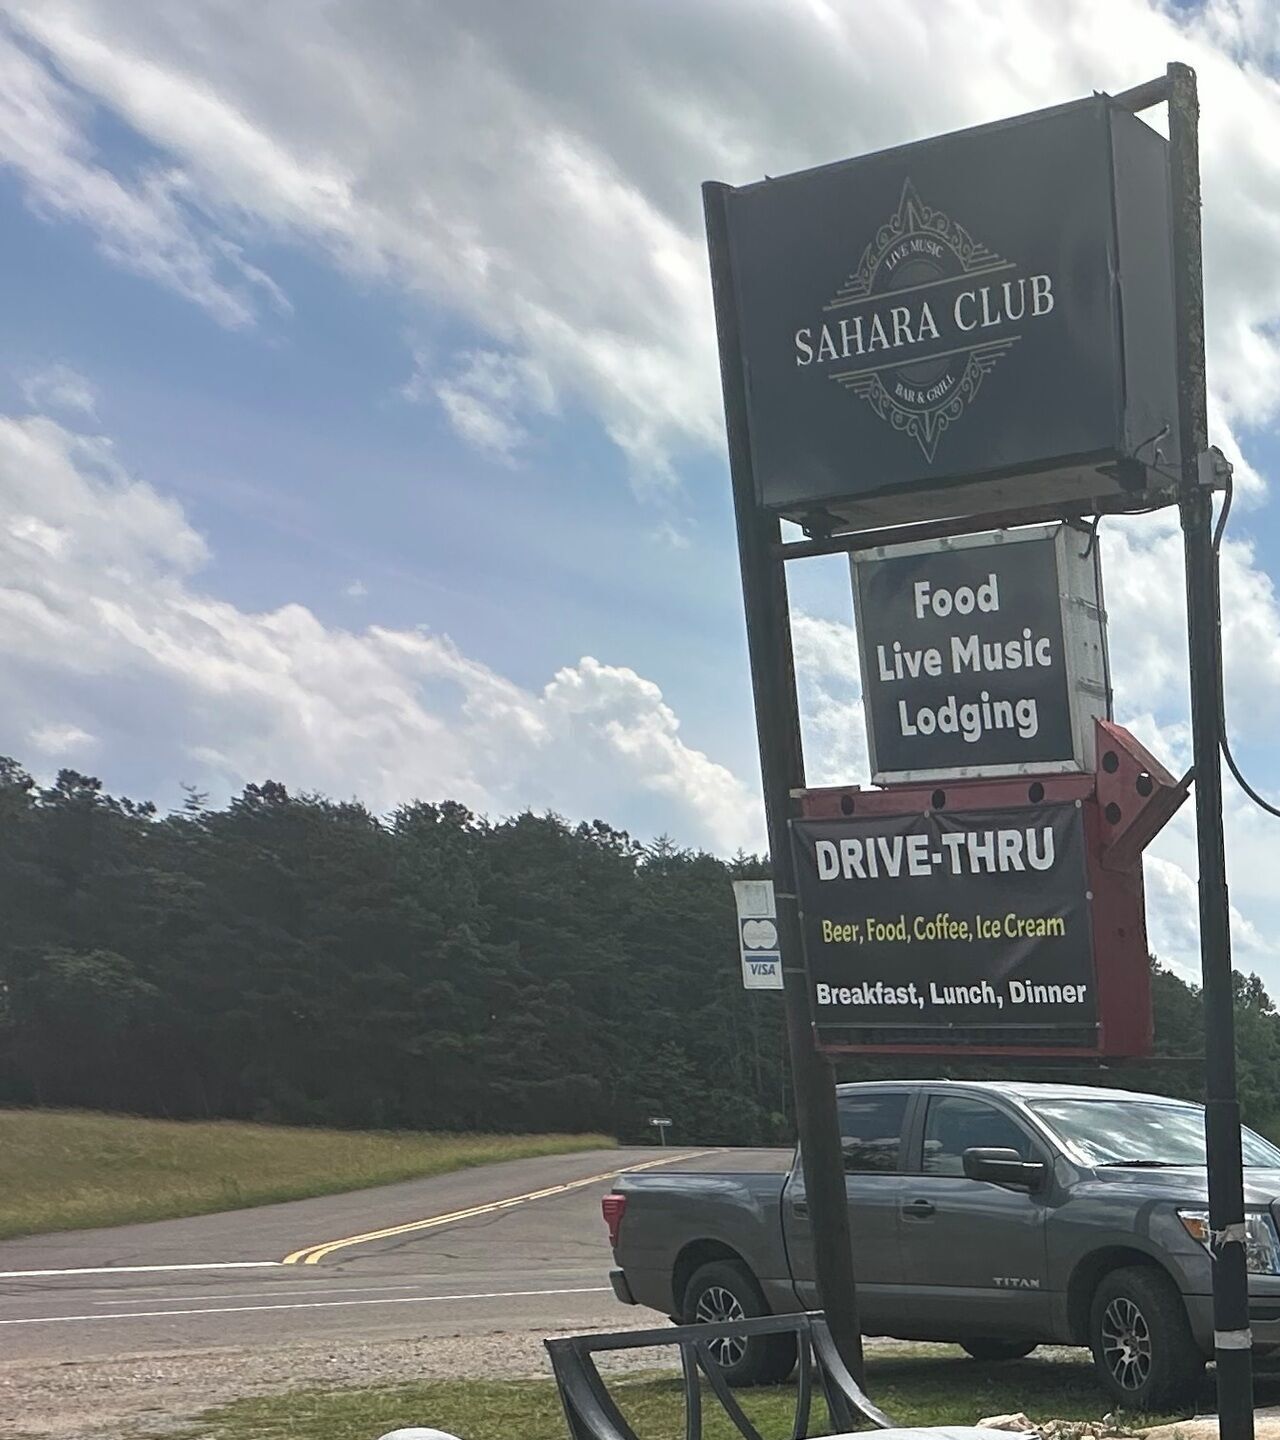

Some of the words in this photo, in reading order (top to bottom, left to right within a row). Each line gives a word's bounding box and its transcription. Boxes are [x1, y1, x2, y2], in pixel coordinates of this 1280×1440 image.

[885, 245, 909, 272] LIVE
[909, 238, 944, 258] MUSIC
[794, 301, 941, 367] SAHARA
[954, 274, 1055, 332] CLUB
[895, 382, 916, 403] BAR
[926, 373, 956, 401] GRILL
[914, 573, 1000, 619] Food
[877, 641, 942, 681] Live
[950, 627, 1052, 674] Music
[899, 690, 1039, 742] Lodging
[815, 827, 1055, 881] DRIVE-THRU
[822, 919, 864, 945] Beer,
[866, 915, 911, 943] Food,
[914, 913, 973, 942] Coffee,
[976, 915, 1001, 938] Ice
[1004, 913, 1066, 938] Cream
[750, 963, 775, 976] VISA
[816, 981, 925, 1010] Breakfast,
[929, 980, 1004, 1009] Lunch,
[1008, 980, 1087, 1004] Dinner
[993, 1277, 1040, 1288] TITAN
